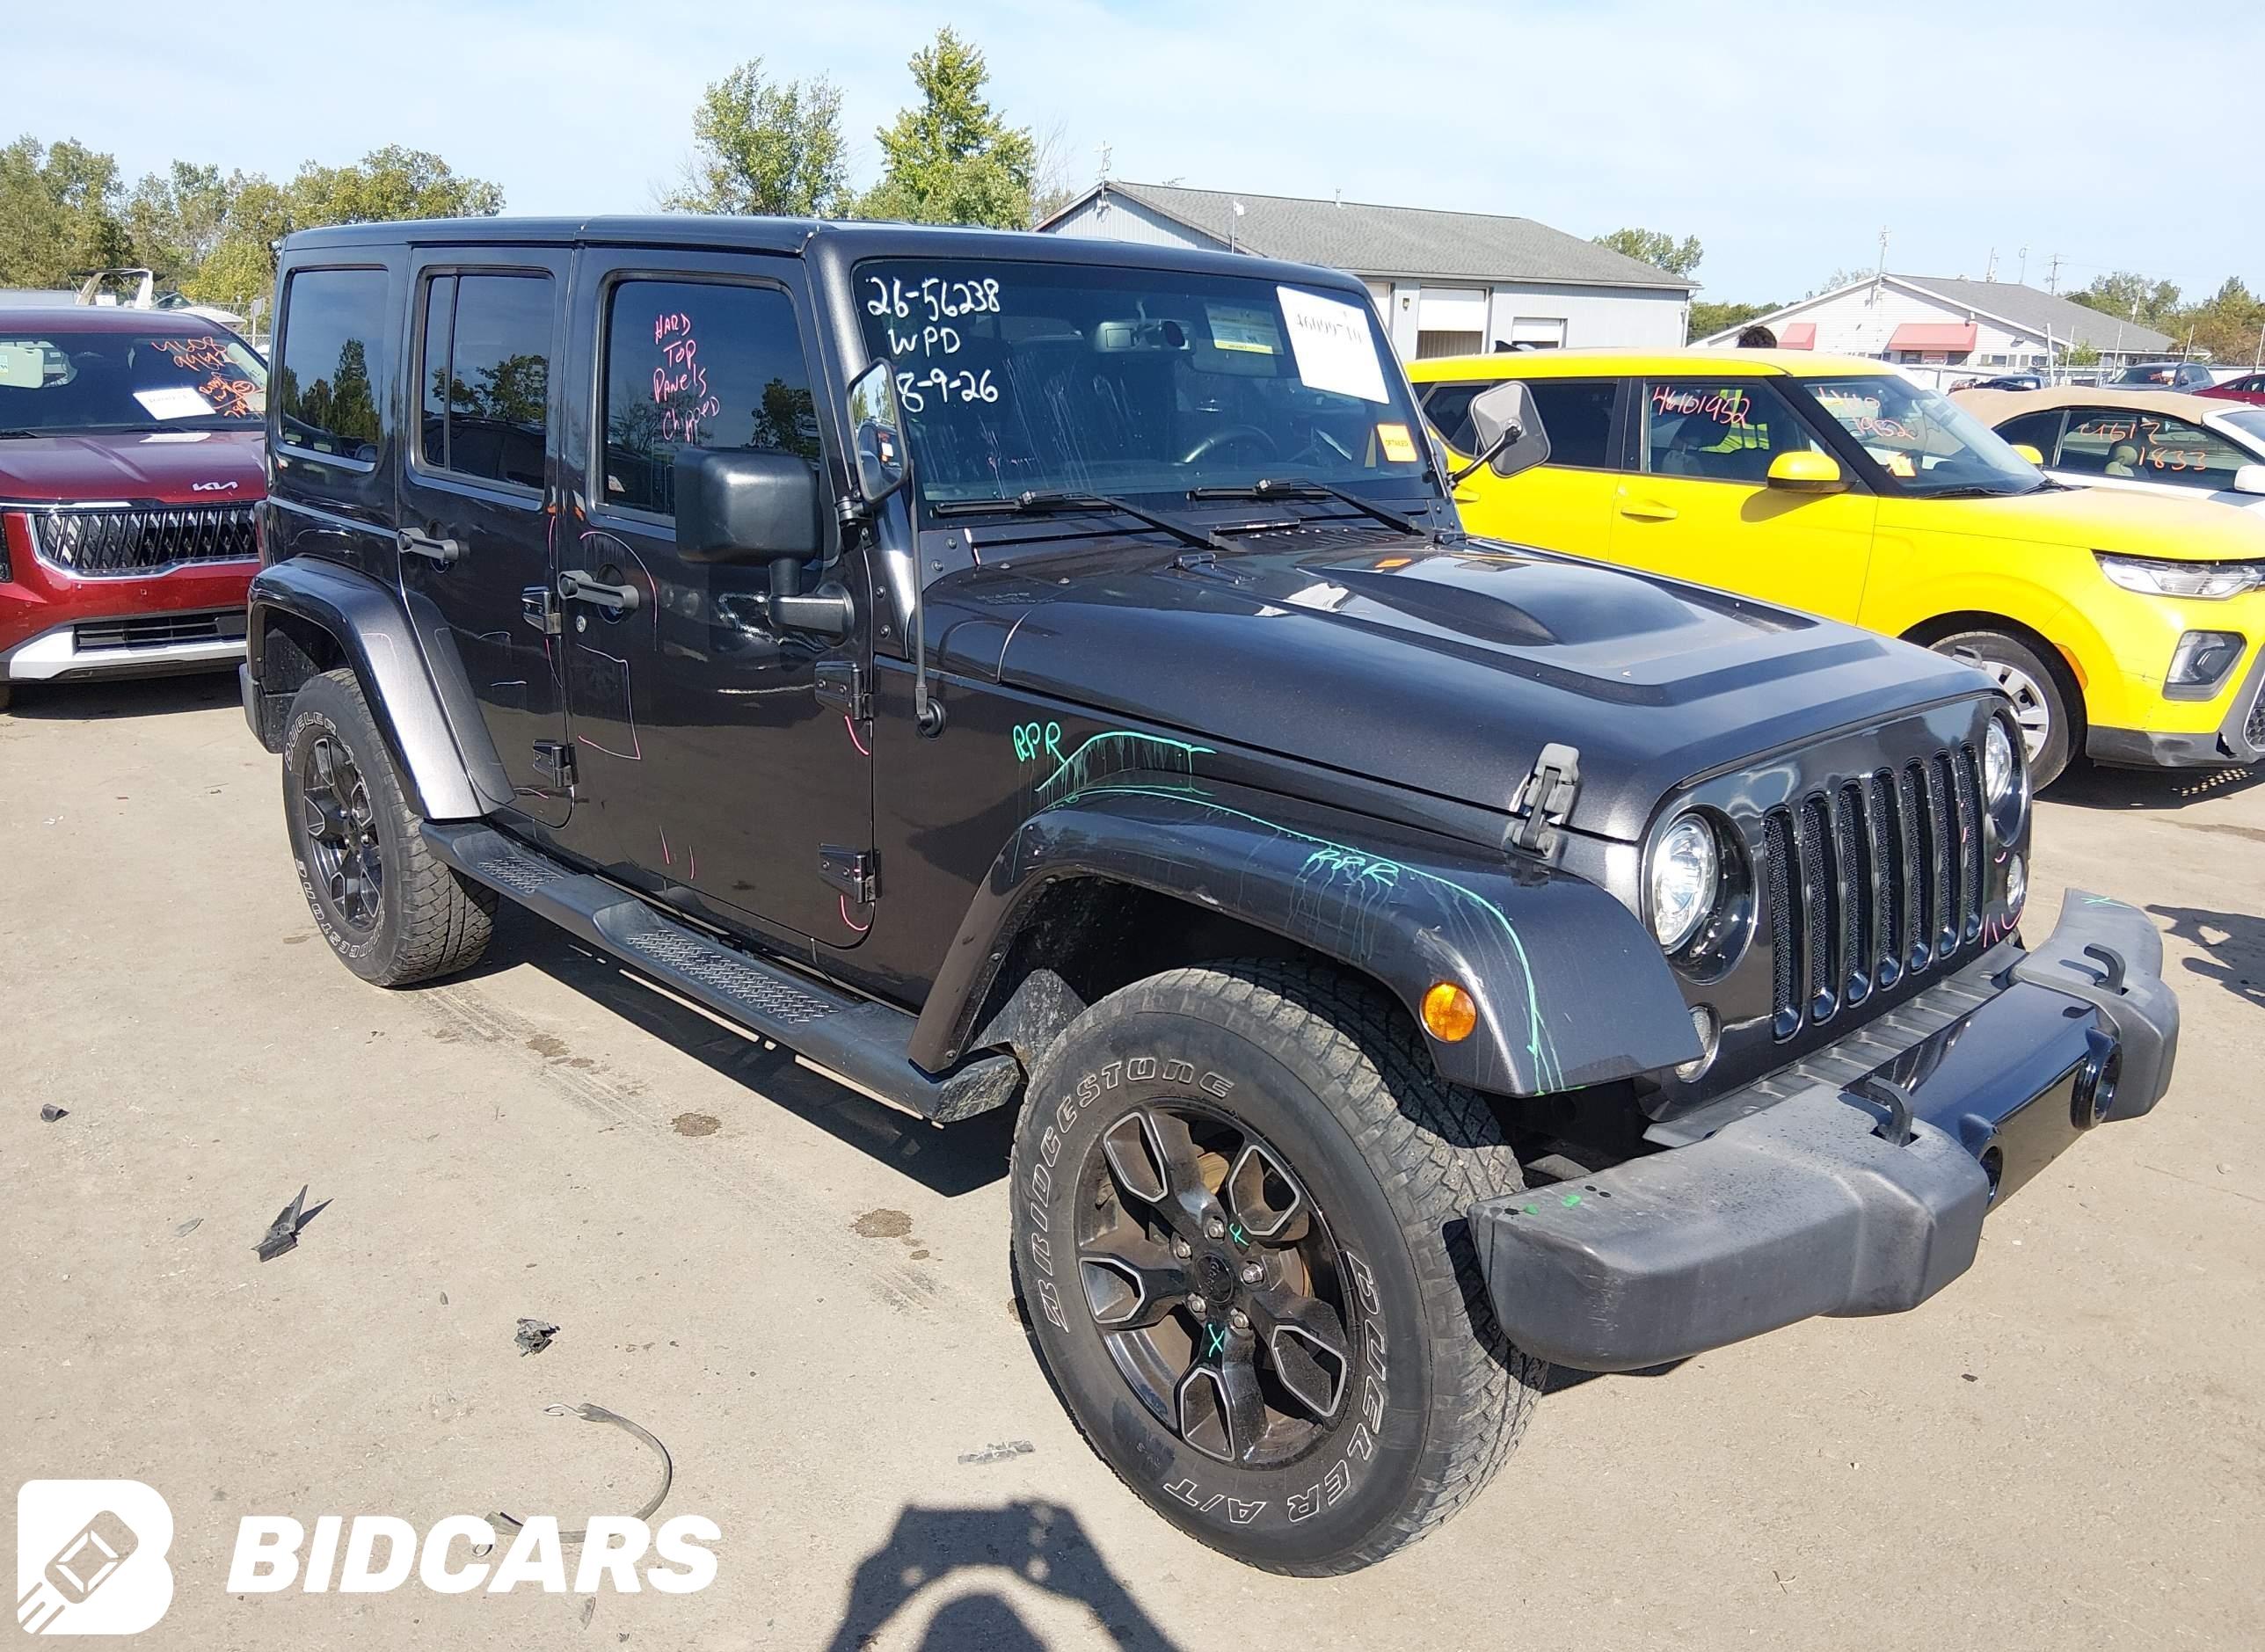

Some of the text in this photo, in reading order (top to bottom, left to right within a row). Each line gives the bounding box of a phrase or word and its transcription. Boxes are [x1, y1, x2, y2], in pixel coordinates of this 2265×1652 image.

[865, 277, 1001, 322] 26-56238
[654, 313, 691, 345] HARD
[887, 326, 960, 358] WPD
[895, 368, 999, 412] 8-9-26
[2138, 446, 2207, 470] 1833
[284, 711, 337, 772] DUELER
[1013, 721, 1067, 763] RPR
[1030, 1057, 1234, 1333] BRIDGESTONE
[1287, 1250, 1387, 1523] DUELER
[1162, 1478, 1267, 1524] A/T
